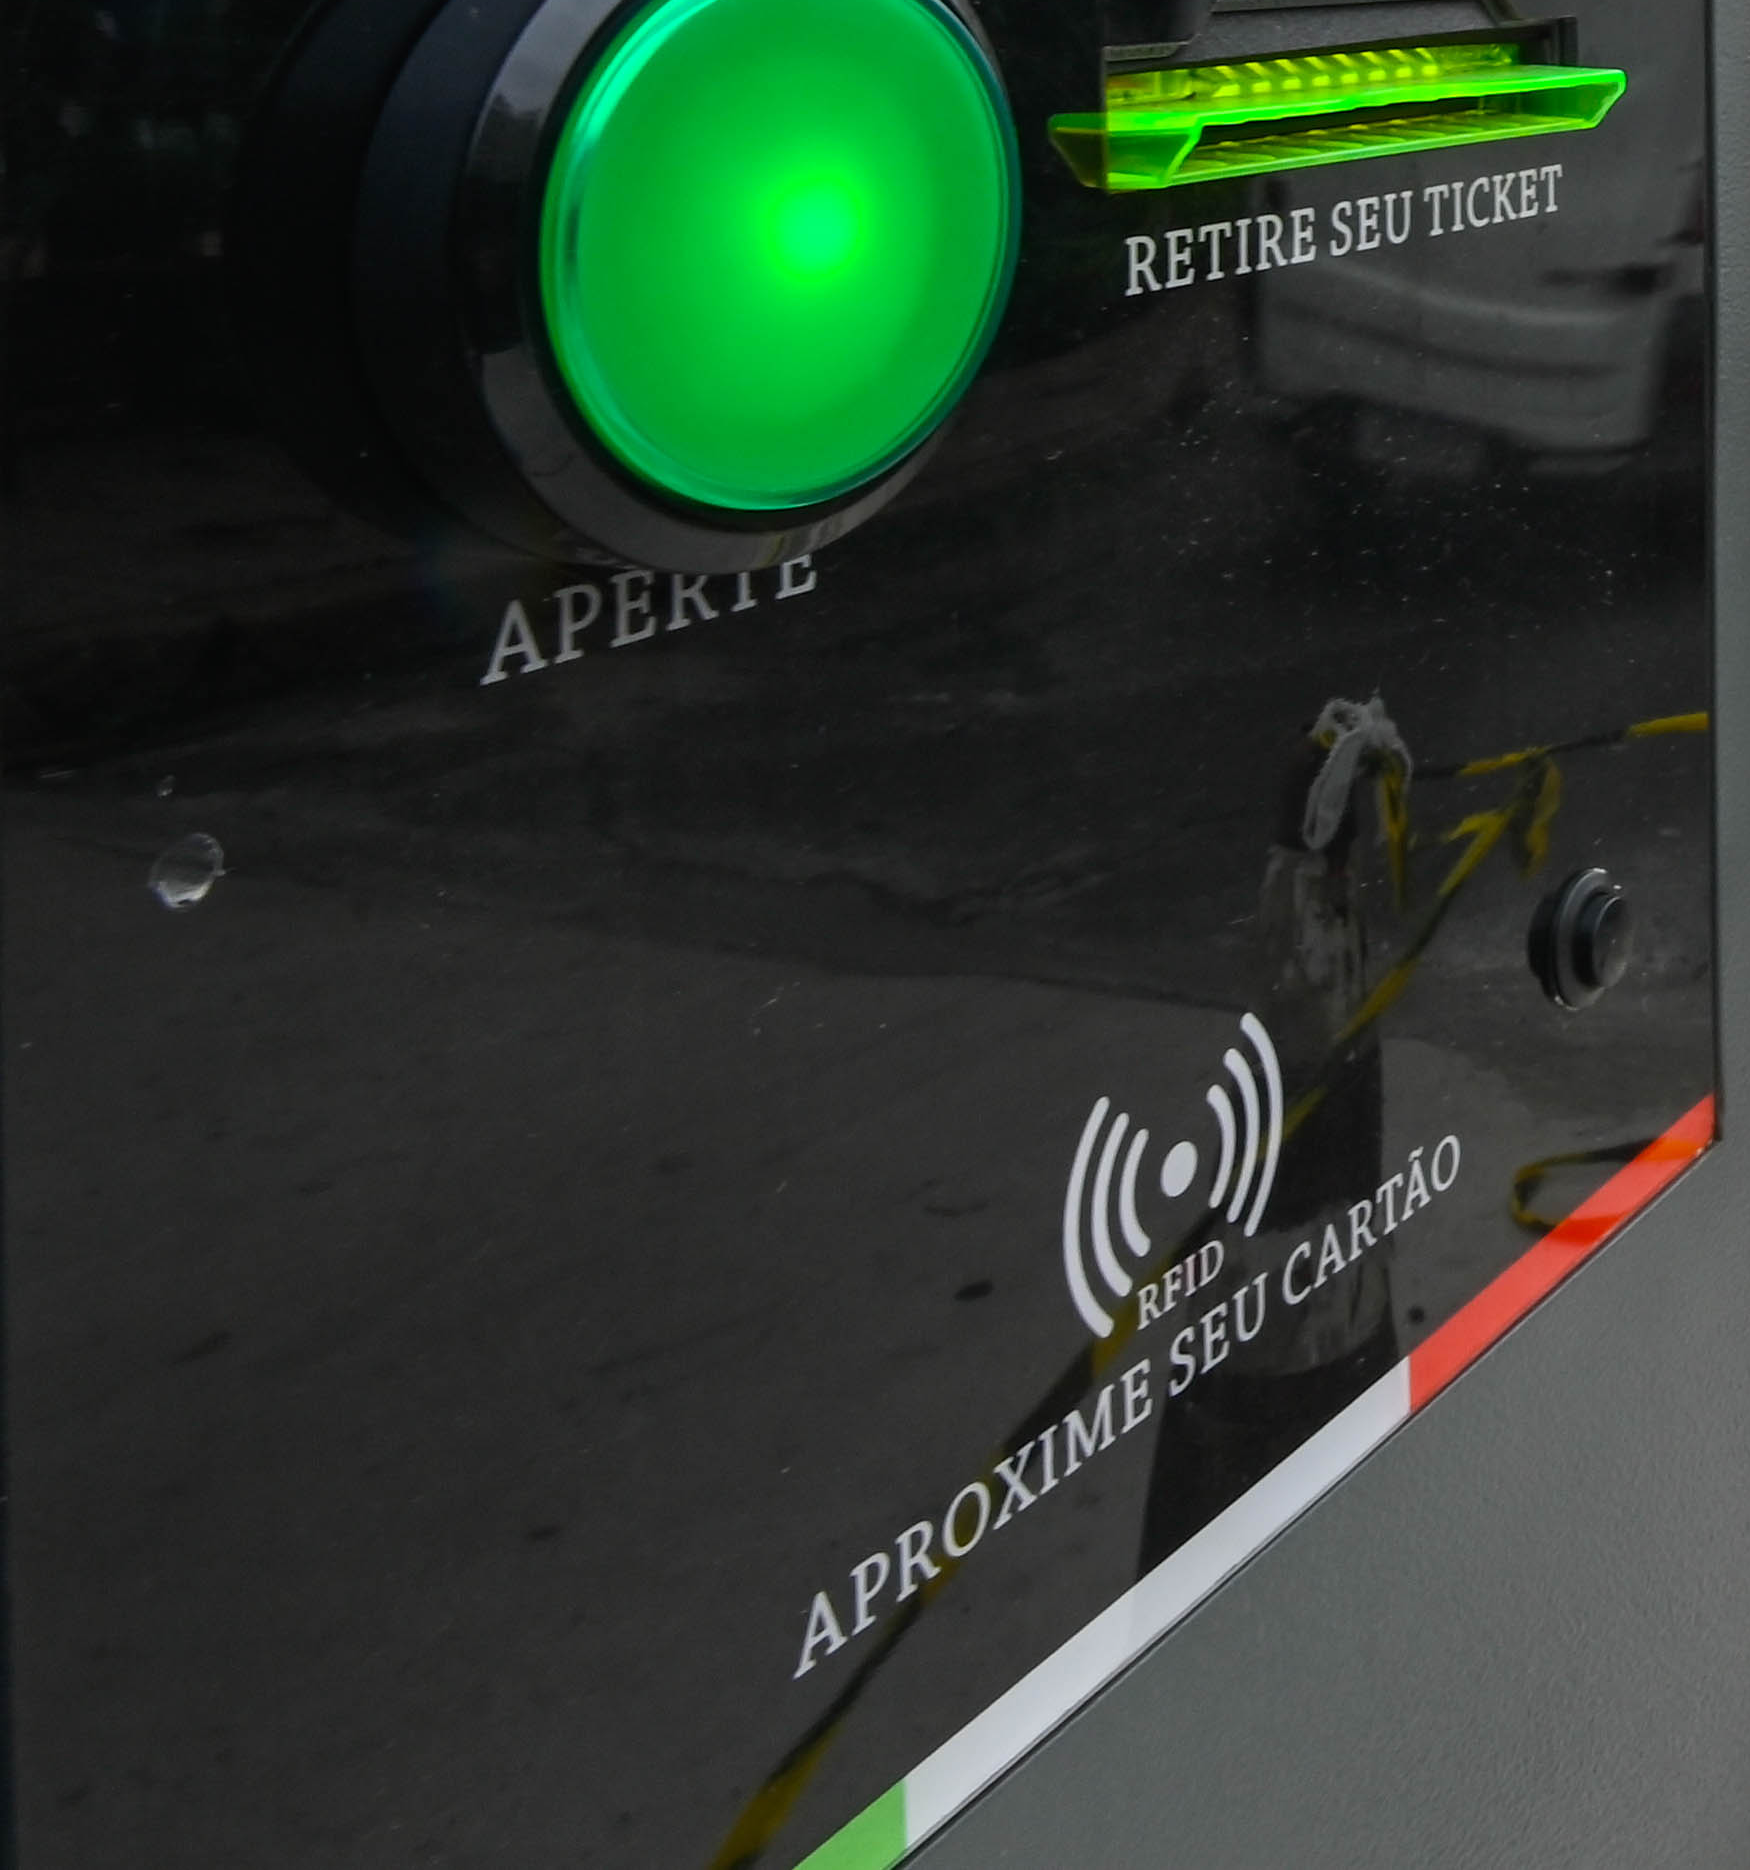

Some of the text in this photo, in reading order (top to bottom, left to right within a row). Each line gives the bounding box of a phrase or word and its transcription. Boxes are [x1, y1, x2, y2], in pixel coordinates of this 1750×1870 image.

[1125, 163, 1564, 296] RETIRE SEU TICKET
[1136, 1237, 1226, 1332] RFID
[792, 1133, 1463, 1680] APROXIME SEU CARTÃO
